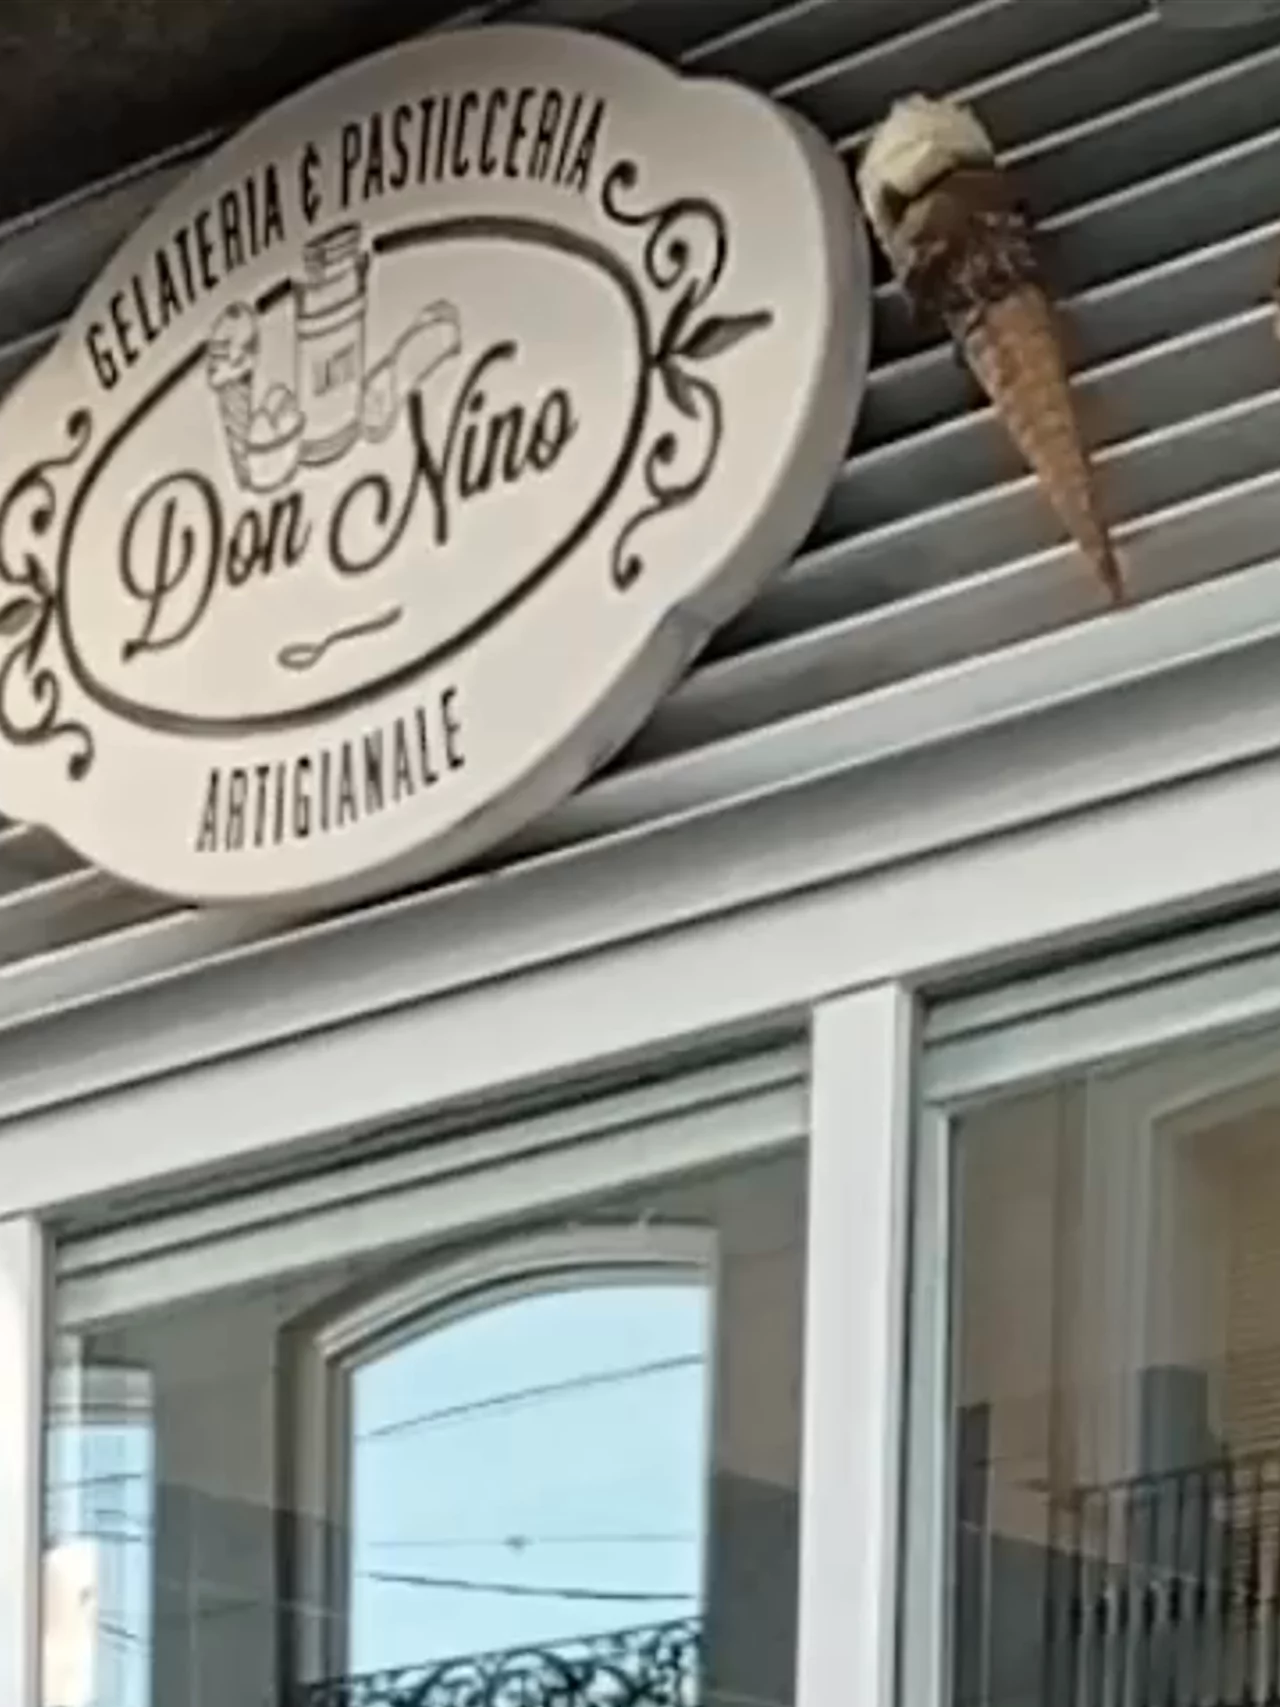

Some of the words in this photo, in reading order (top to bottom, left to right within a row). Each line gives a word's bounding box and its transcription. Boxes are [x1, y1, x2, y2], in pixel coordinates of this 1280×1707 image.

[83, 163, 286, 391] GELATERIA
[337, 84, 608, 211] PASTICCERIA
[119, 470, 312, 662] Don
[327, 340, 578, 575] Nino
[195, 684, 465, 853] ARTIGIANALE
